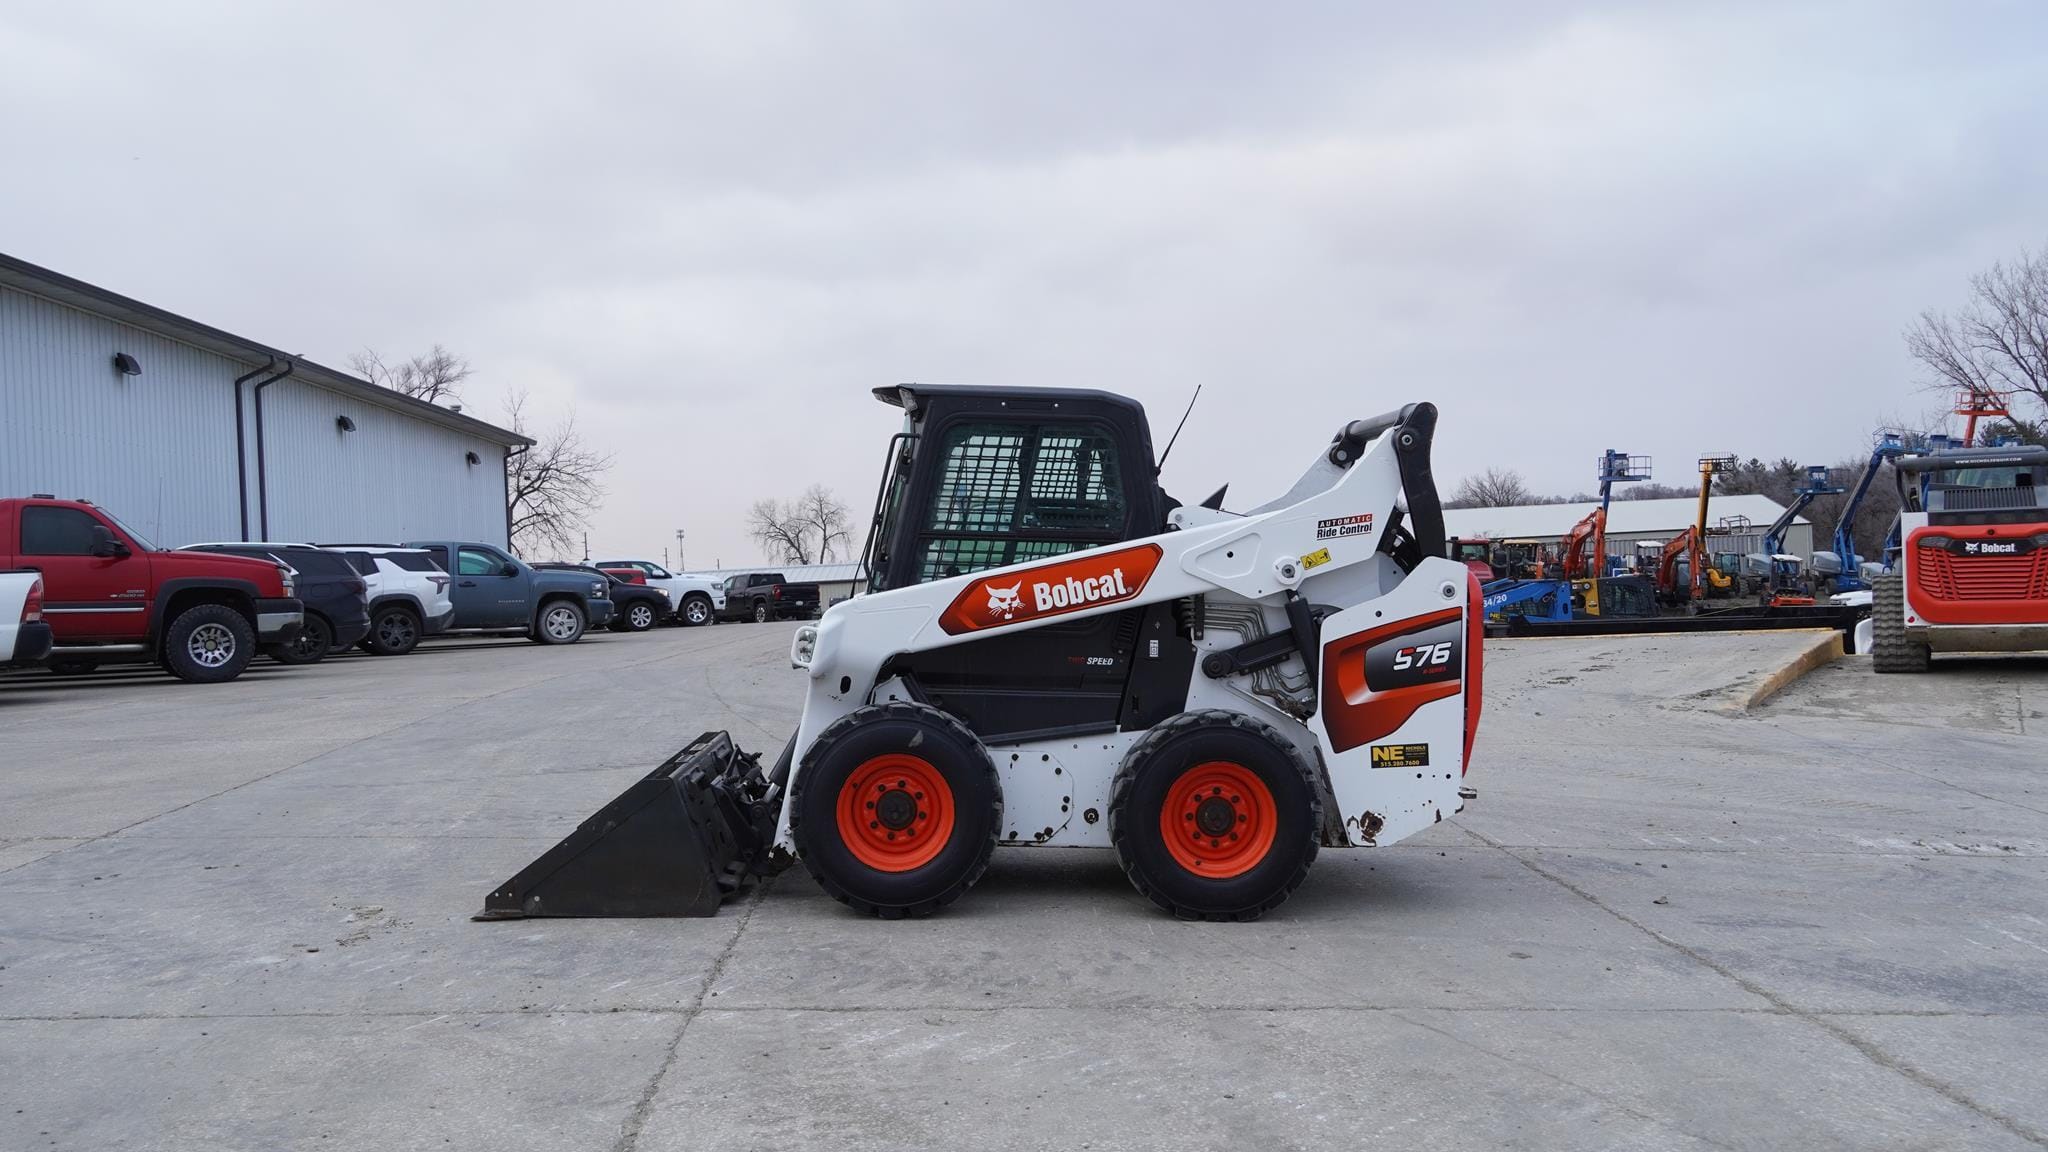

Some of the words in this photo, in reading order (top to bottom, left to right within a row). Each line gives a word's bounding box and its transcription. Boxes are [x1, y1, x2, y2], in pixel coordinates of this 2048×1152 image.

[1320, 514, 1371, 527] AUTOMATIC
[1316, 528, 1337, 538] Ride
[1340, 523, 1372, 535] Control
[1981, 543, 2015, 553] Bobcat
[1033, 568, 1127, 612] Bobcat
[1086, 656, 1114, 665] SPEED
[1393, 642, 1452, 671] S76
[1372, 745, 1405, 761] NE
